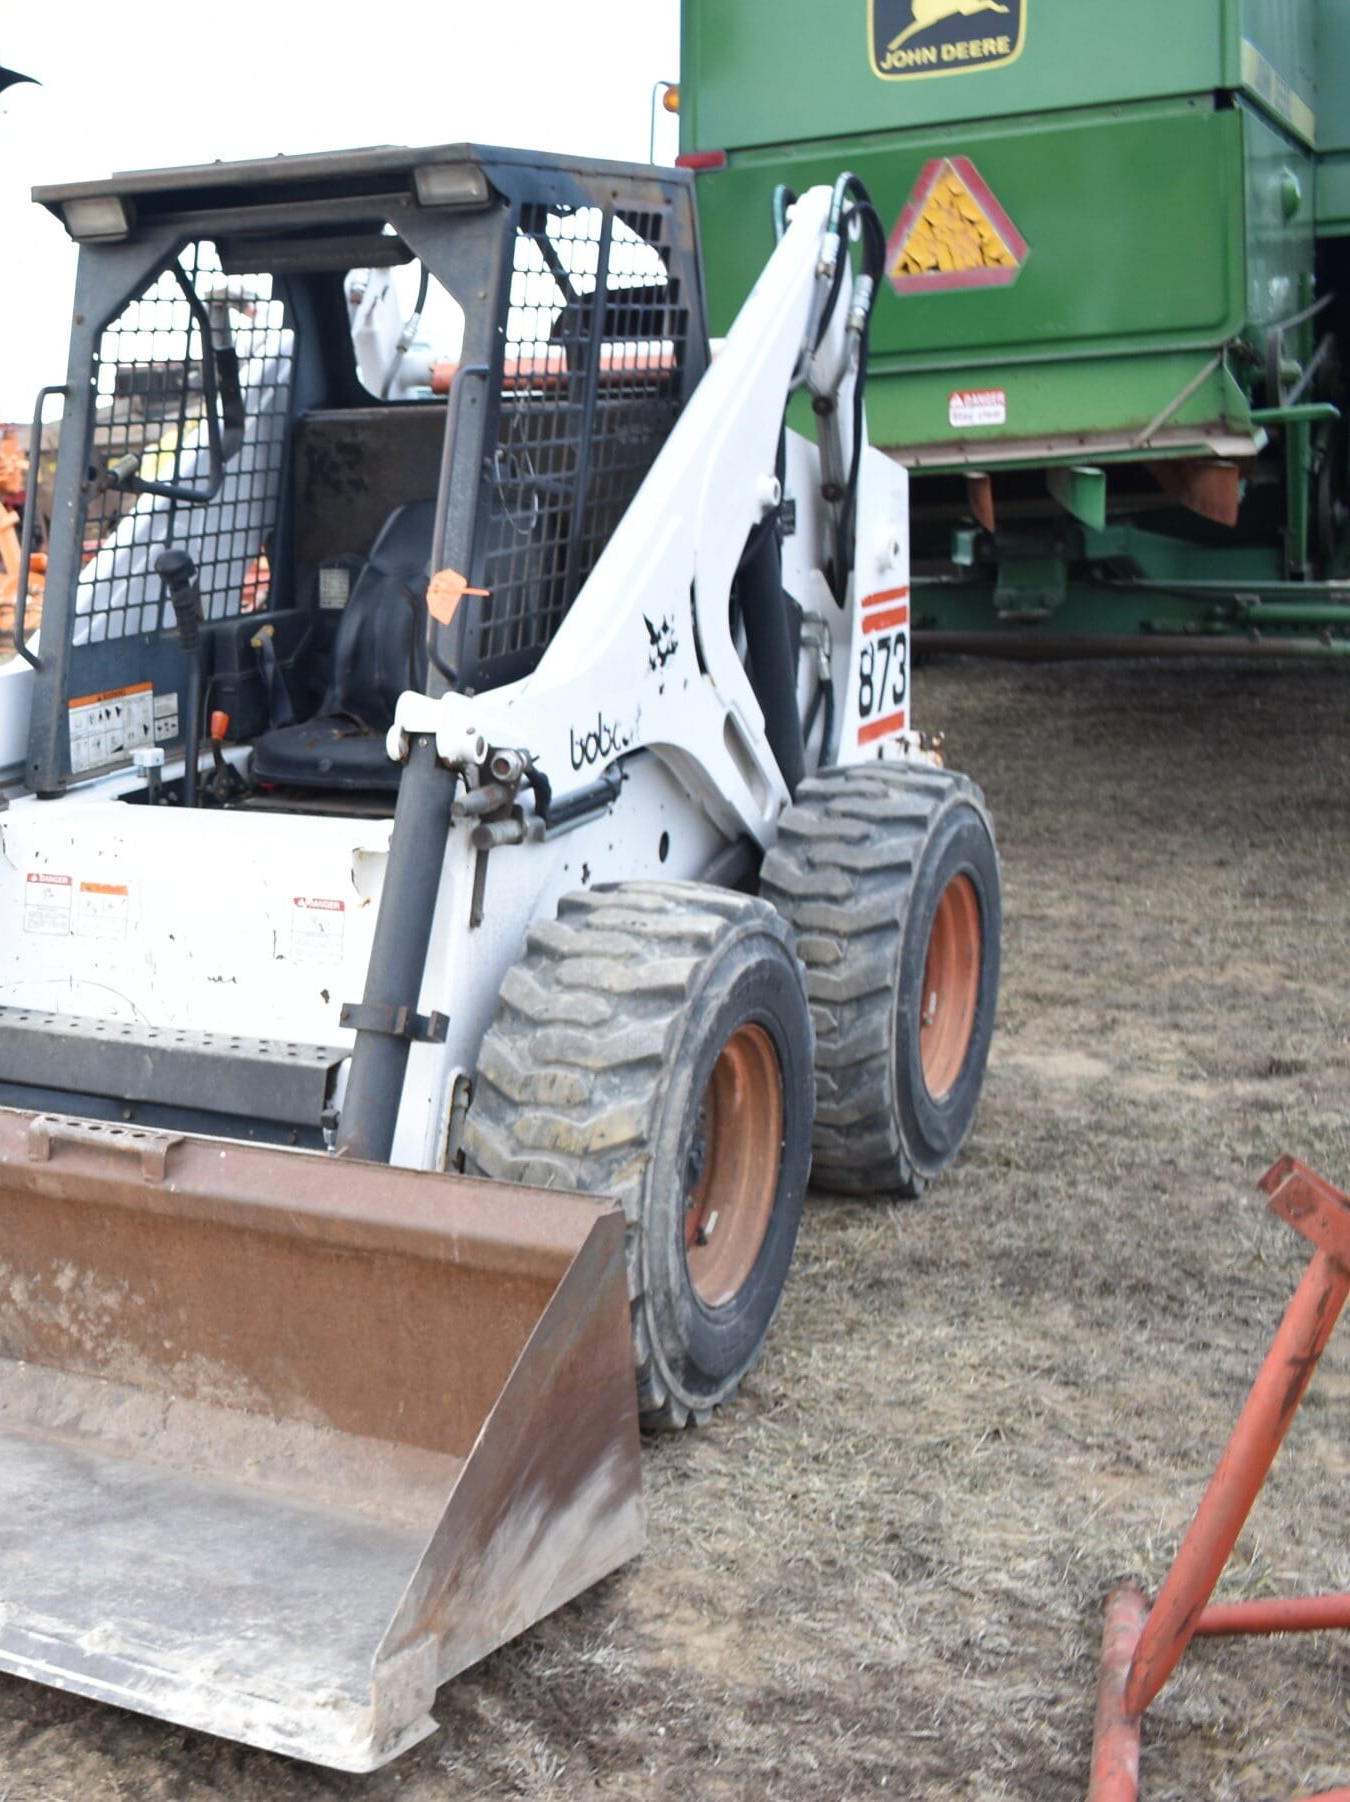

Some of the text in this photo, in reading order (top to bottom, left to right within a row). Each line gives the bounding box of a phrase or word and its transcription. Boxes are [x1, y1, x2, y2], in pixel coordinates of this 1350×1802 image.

[880, 35, 1011, 70] JOHN DEERE
[858, 631, 907, 719] 873
[569, 705, 642, 771] bobc
